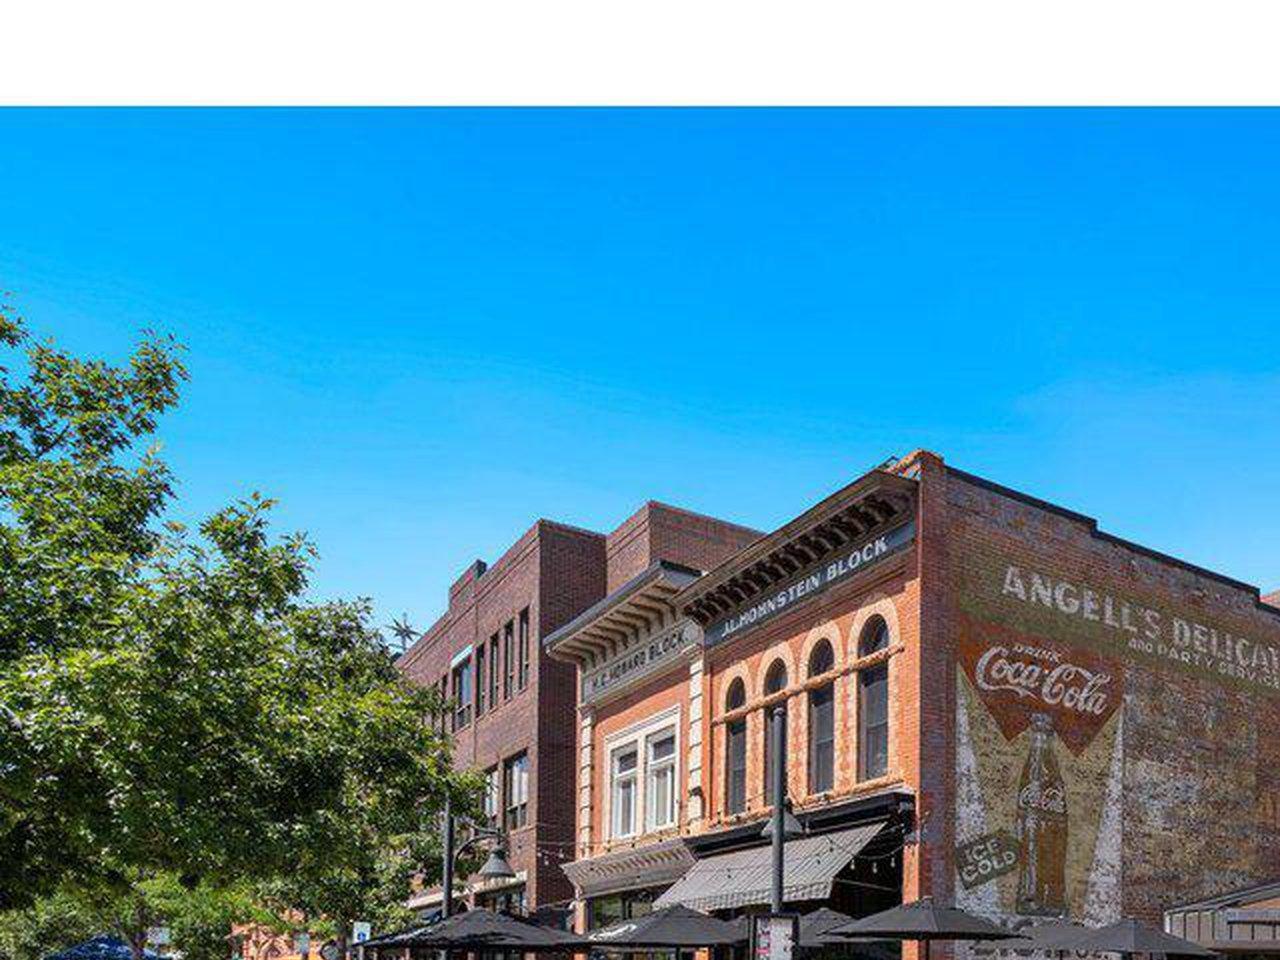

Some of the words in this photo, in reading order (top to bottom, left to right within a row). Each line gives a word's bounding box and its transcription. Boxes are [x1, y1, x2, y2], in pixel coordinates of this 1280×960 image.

[826, 536, 888, 581] BLOCK
[1002, 565, 1161, 638] ANGELL'S
[1156, 643, 1214, 667] PARTY
[961, 850, 1017, 882] COLD
